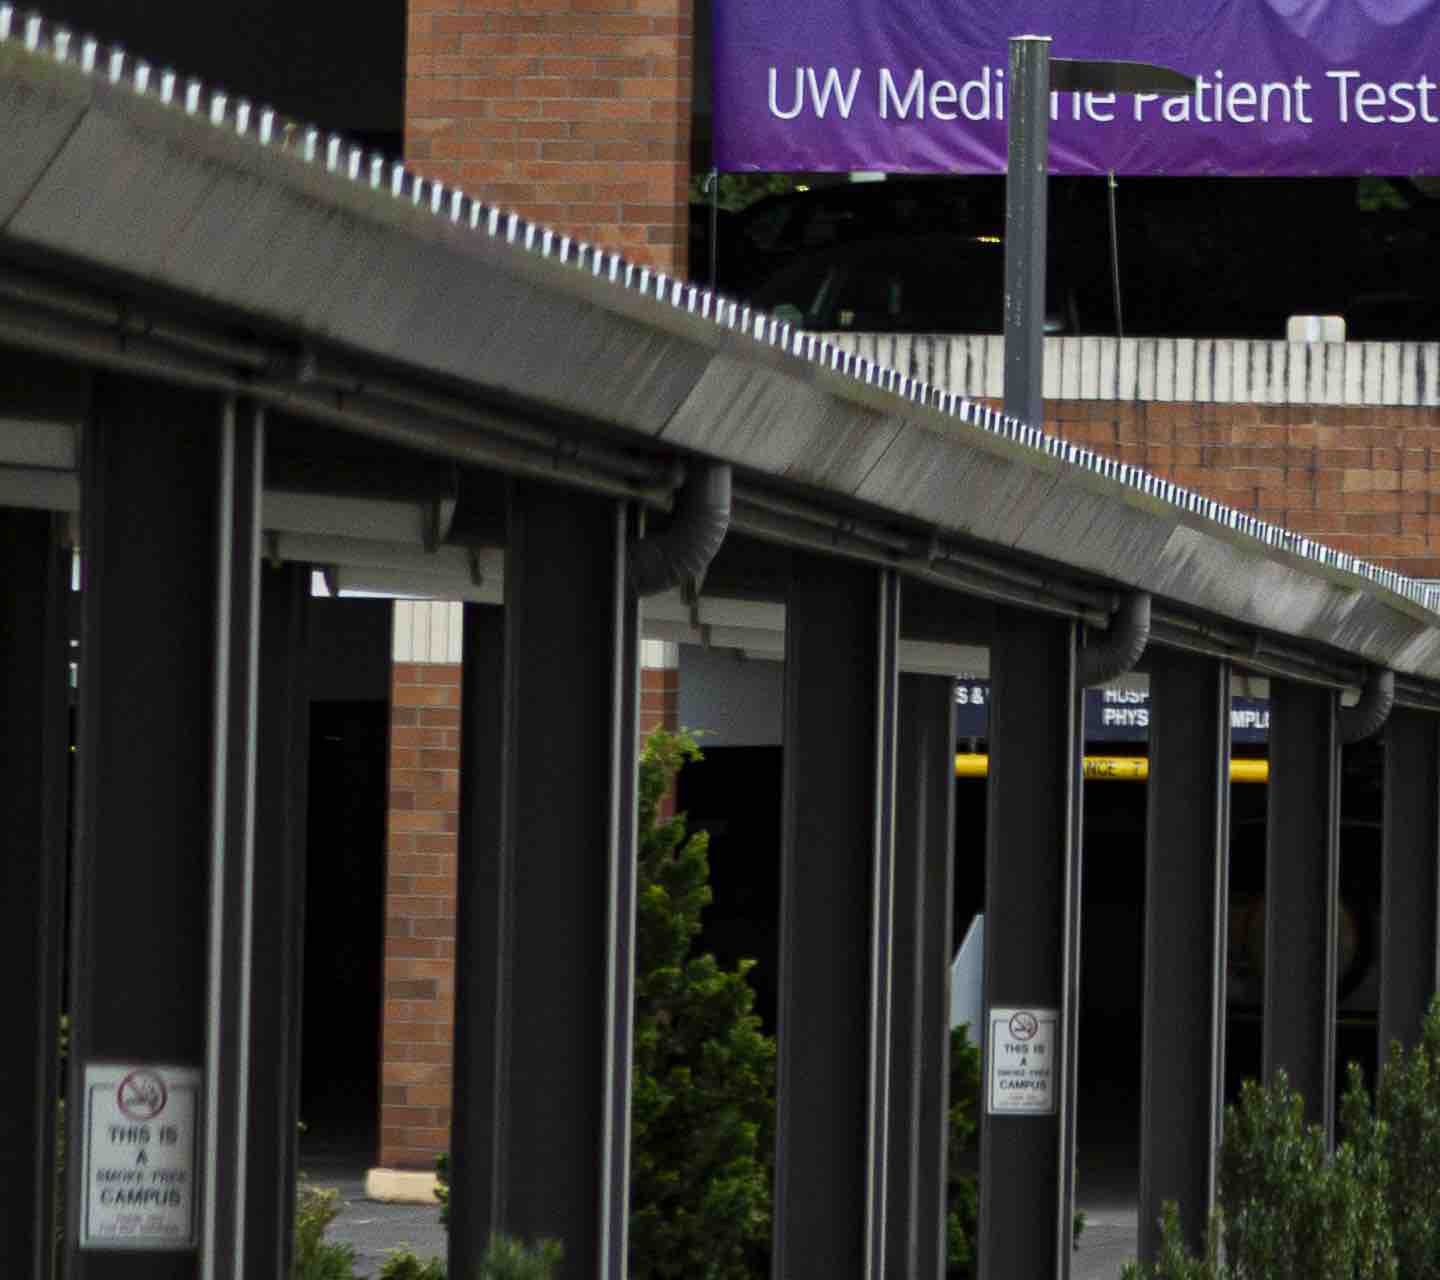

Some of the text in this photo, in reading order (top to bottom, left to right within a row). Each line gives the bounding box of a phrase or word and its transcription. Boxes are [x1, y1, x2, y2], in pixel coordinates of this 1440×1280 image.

[767, 65, 861, 121] UW
[878, 65, 1117, 122] Medine
[1102, 707, 1150, 728] PHYS
[101, 1188, 181, 1207] CAMPUS
